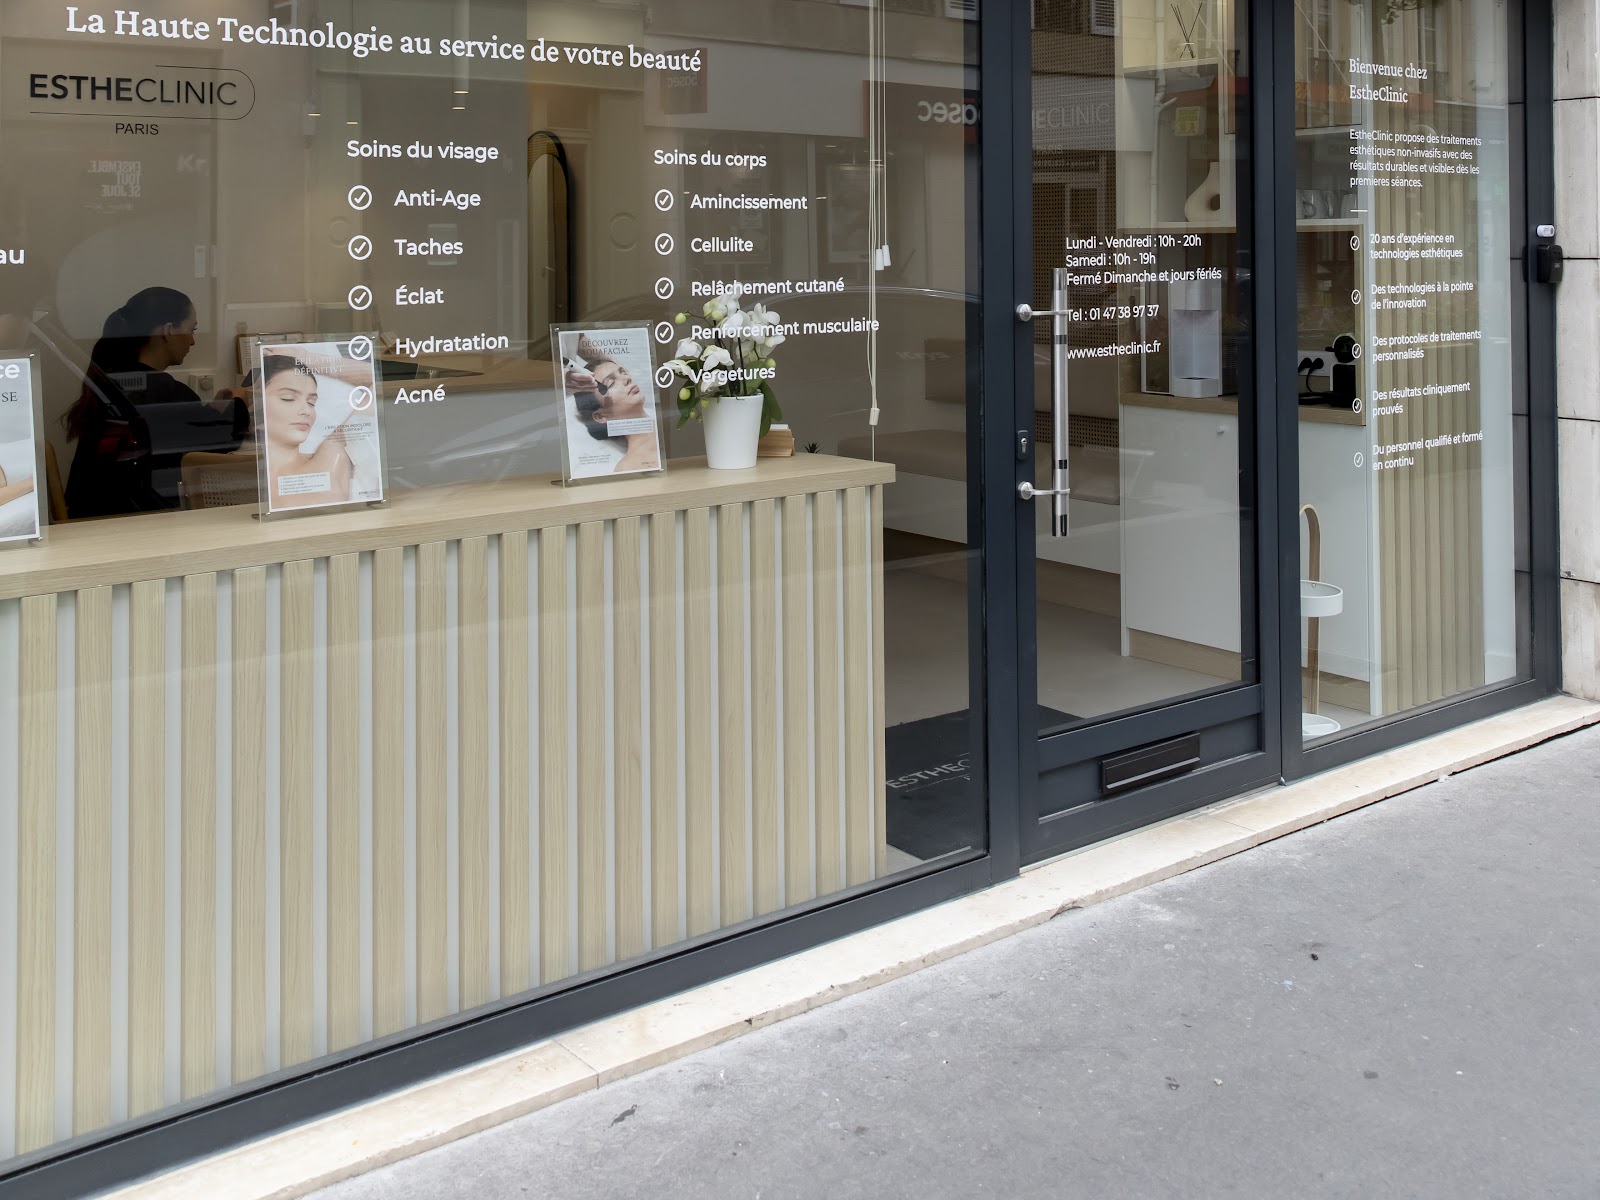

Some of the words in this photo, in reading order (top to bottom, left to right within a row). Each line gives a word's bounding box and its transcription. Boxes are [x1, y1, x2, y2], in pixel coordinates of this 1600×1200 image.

[66, 6, 106, 33] La
[114, 10, 210, 40] Haute
[217, 17, 393, 58] Technologie
[400, 36, 432, 55] au
[439, 35, 525, 60] service
[531, 38, 559, 63] de
[564, 47, 623, 67] votre
[629, 44, 701, 72] beauté
[1349, 58, 1403, 77] Bienvenue
[1405, 63, 1428, 80] chez
[29, 73, 238, 105] ESTHECLINIC
[1349, 84, 1408, 103] EstheClinic
[115, 122, 159, 135] PARIS
[1350, 129, 1393, 142] EstheClinic
[1394, 133, 1425, 145] propose
[1426, 132, 1439, 143] des
[1440, 133, 1482, 146] traitements
[346, 140, 401, 158] Soins
[407, 141, 432, 158] du
[438, 142, 499, 163] visage
[654, 149, 697, 165] Soins
[701, 150, 721, 166] du
[725, 153, 767, 170] corps
[1350, 145, 1395, 159] esthétiques
[1396, 147, 1441, 159] non-invasifs
[1442, 151, 1459, 159] avec
[1460, 149, 1473, 160] des
[1350, 160, 1384, 171] résultats
[1385, 161, 1418, 173] durables
[1419, 163, 1427, 173] et
[1428, 162, 1455, 174] visibles
[1456, 163, 1468, 174] dès
[1469, 164, 1480, 174] les
[1391, 177, 1423, 188] séances.
[394, 189, 481, 210] Anti-Age
[690, 193, 808, 210] Amincissement
[394, 238, 463, 256] Taches
[691, 236, 754, 252] Cellulite
[1066, 236, 1097, 250] Lundi
[1105, 235, 1152, 249] Vendredi
[1159, 235, 1176, 247] 10h
[1183, 234, 1202, 247] 20h
[1370, 233, 1380, 244] 20
[1381, 236, 1395, 244] ans
[1397, 232, 1444, 245] d'expérience
[1445, 235, 1454, 243] en
[1065, 253, 1106, 267] Samedi
[1113, 253, 1131, 265] 10h
[1139, 252, 1156, 265] 19h
[1370, 248, 1419, 260] technologies
[1421, 247, 1463, 260] esthétiques
[1067, 272, 1102, 285] Fermé
[1104, 269, 1157, 284] Dimanche
[1158, 271, 1169, 282] et
[1169, 269, 1195, 284] jours
[1196, 266, 1222, 280] fériés
[395, 285, 445, 305] Éclat
[691, 278, 792, 296] Relâchement
[795, 277, 845, 293] cutané
[1371, 284, 1386, 295] Des
[1387, 282, 1436, 296] technologies
[1442, 281, 1449, 291] la
[1450, 280, 1474, 293] pointe
[1371, 299, 1382, 310] de
[1383, 297, 1427, 309] l'innovation
[1067, 309, 1082, 322] Tel
[1089, 308, 1100, 320] 01
[1103, 306, 1116, 320] 47
[1118, 306, 1131, 318] 38
[1132, 305, 1146, 318] 97
[1147, 304, 1159, 317] 37
[691, 320, 800, 340] Renforcement
[803, 316, 880, 335] musculaire
[395, 333, 509, 358] Hydratation
[1372, 335, 1388, 347] Des
[1388, 332, 1428, 347] protocoles
[1429, 332, 1439, 342] de
[1440, 330, 1482, 342] traitements
[1067, 340, 1161, 360] www.estheclinic.fr
[1372, 348, 1424, 364] personnalisés
[690, 366, 776, 386] Vergetures
[394, 384, 446, 405] Acné
[1372, 390, 1388, 400] Des
[1388, 387, 1421, 399] résultats
[1422, 381, 1471, 396] cliniquement
[1372, 403, 1403, 418] prouvés
[1373, 444, 1385, 456] Du
[1386, 438, 1424, 456] personnel
[1424, 434, 1452, 450] qualifié
[1453, 435, 1461, 444] et
[1461, 430, 1483, 443] formé
[1373, 461, 1383, 471] en
[1384, 456, 1414, 469] continu
